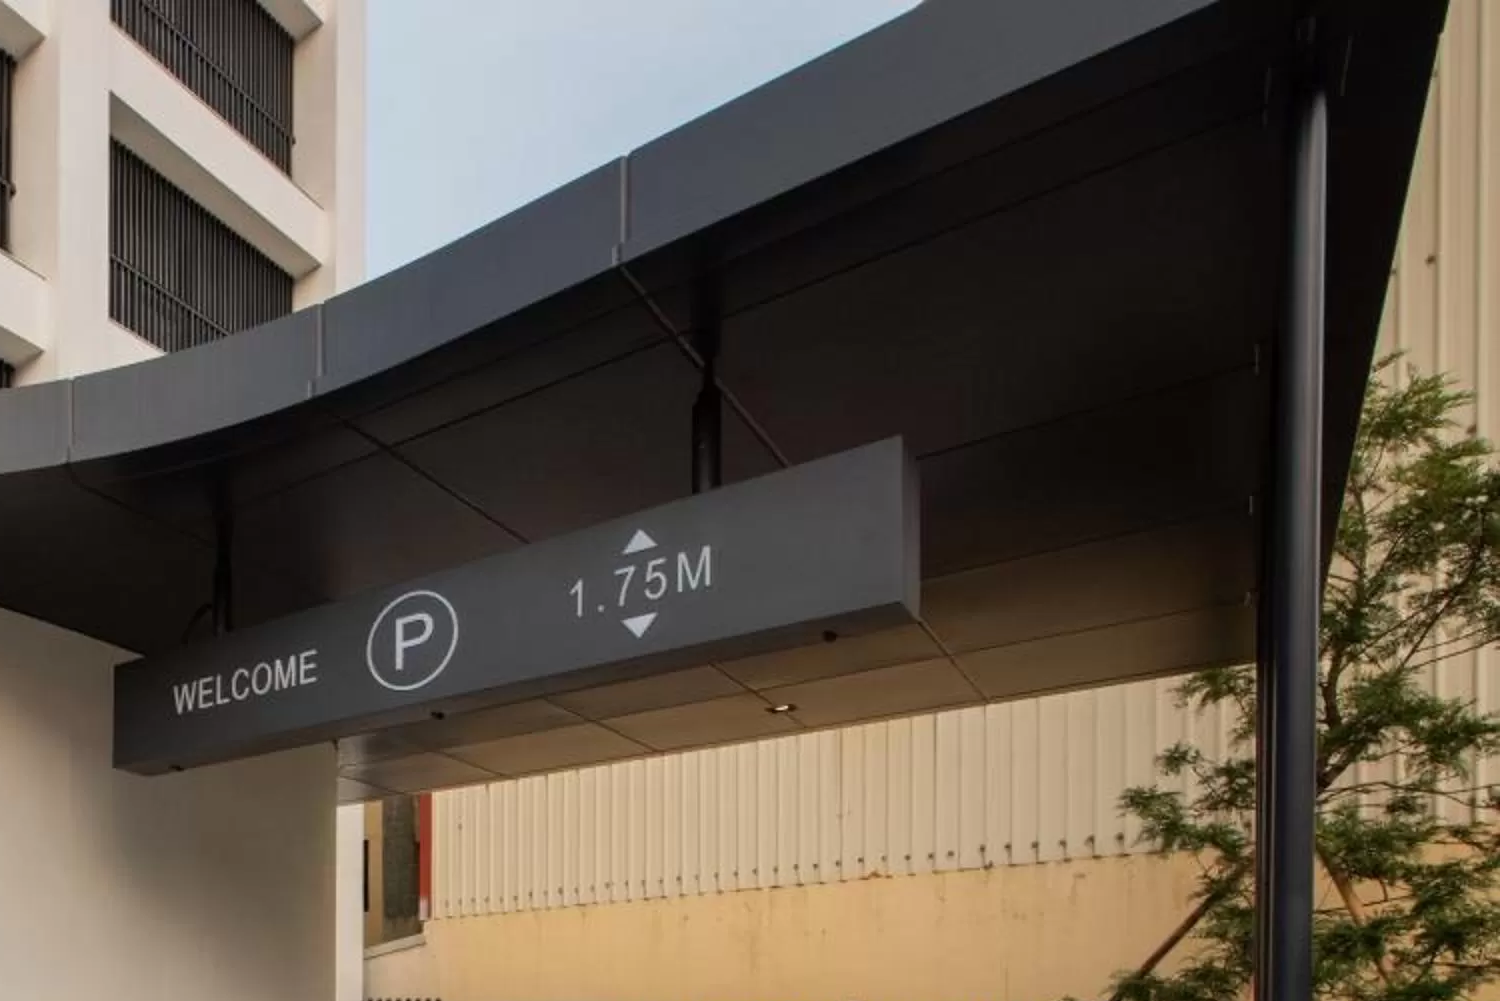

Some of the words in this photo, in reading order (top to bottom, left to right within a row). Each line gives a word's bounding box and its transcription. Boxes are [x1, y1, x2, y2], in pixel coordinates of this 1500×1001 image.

[569, 545, 712, 618] 1.75M
[394, 612, 434, 670] P
[173, 649, 318, 715] WELCOME
